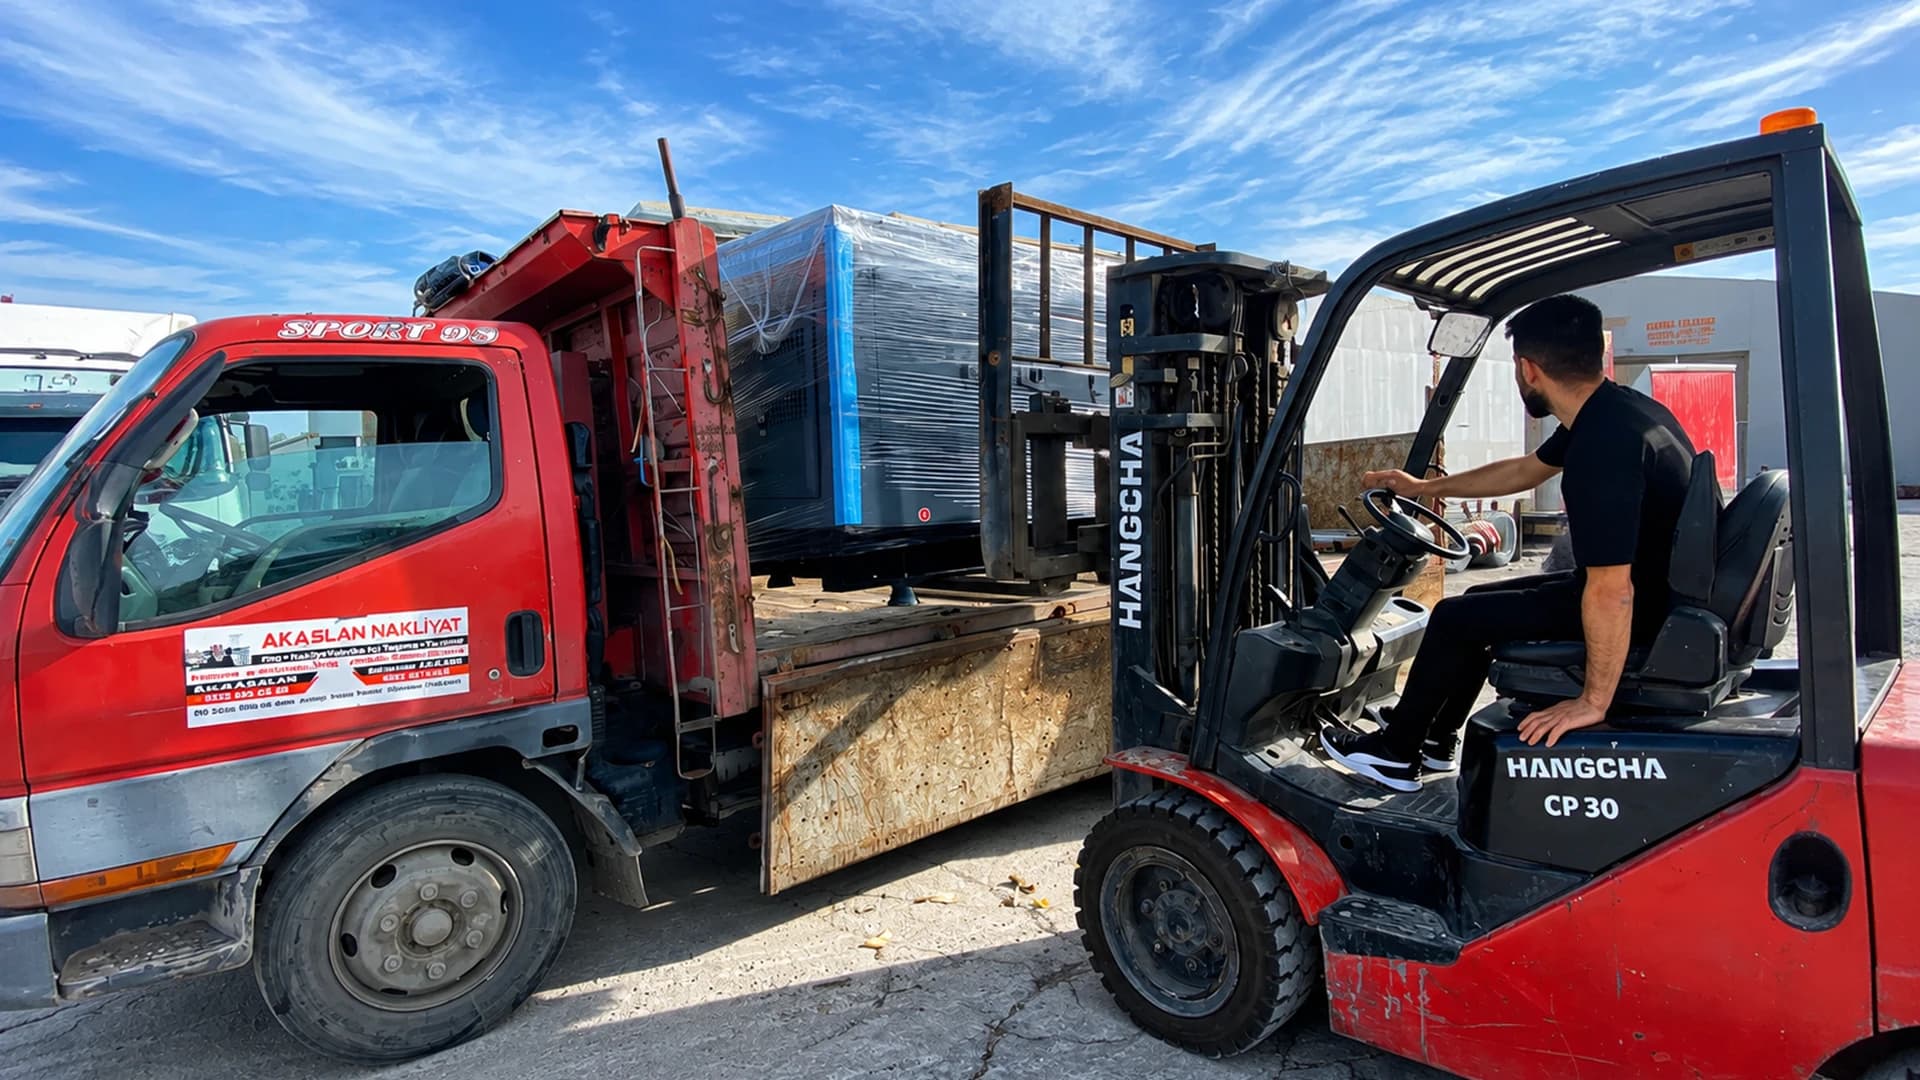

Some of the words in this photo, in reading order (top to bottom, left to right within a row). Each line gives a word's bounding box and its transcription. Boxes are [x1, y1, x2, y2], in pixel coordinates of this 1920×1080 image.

[278, 319, 436, 340] SPORT
[1118, 430, 1143, 630] HANGCHA
[262, 625, 366, 649] AKASLAN
[371, 616, 462, 641] NAKLİYAT
[1506, 757, 1668, 780] HANGCHA
[1544, 794, 1580, 817] CP
[1583, 796, 1620, 820] 30
